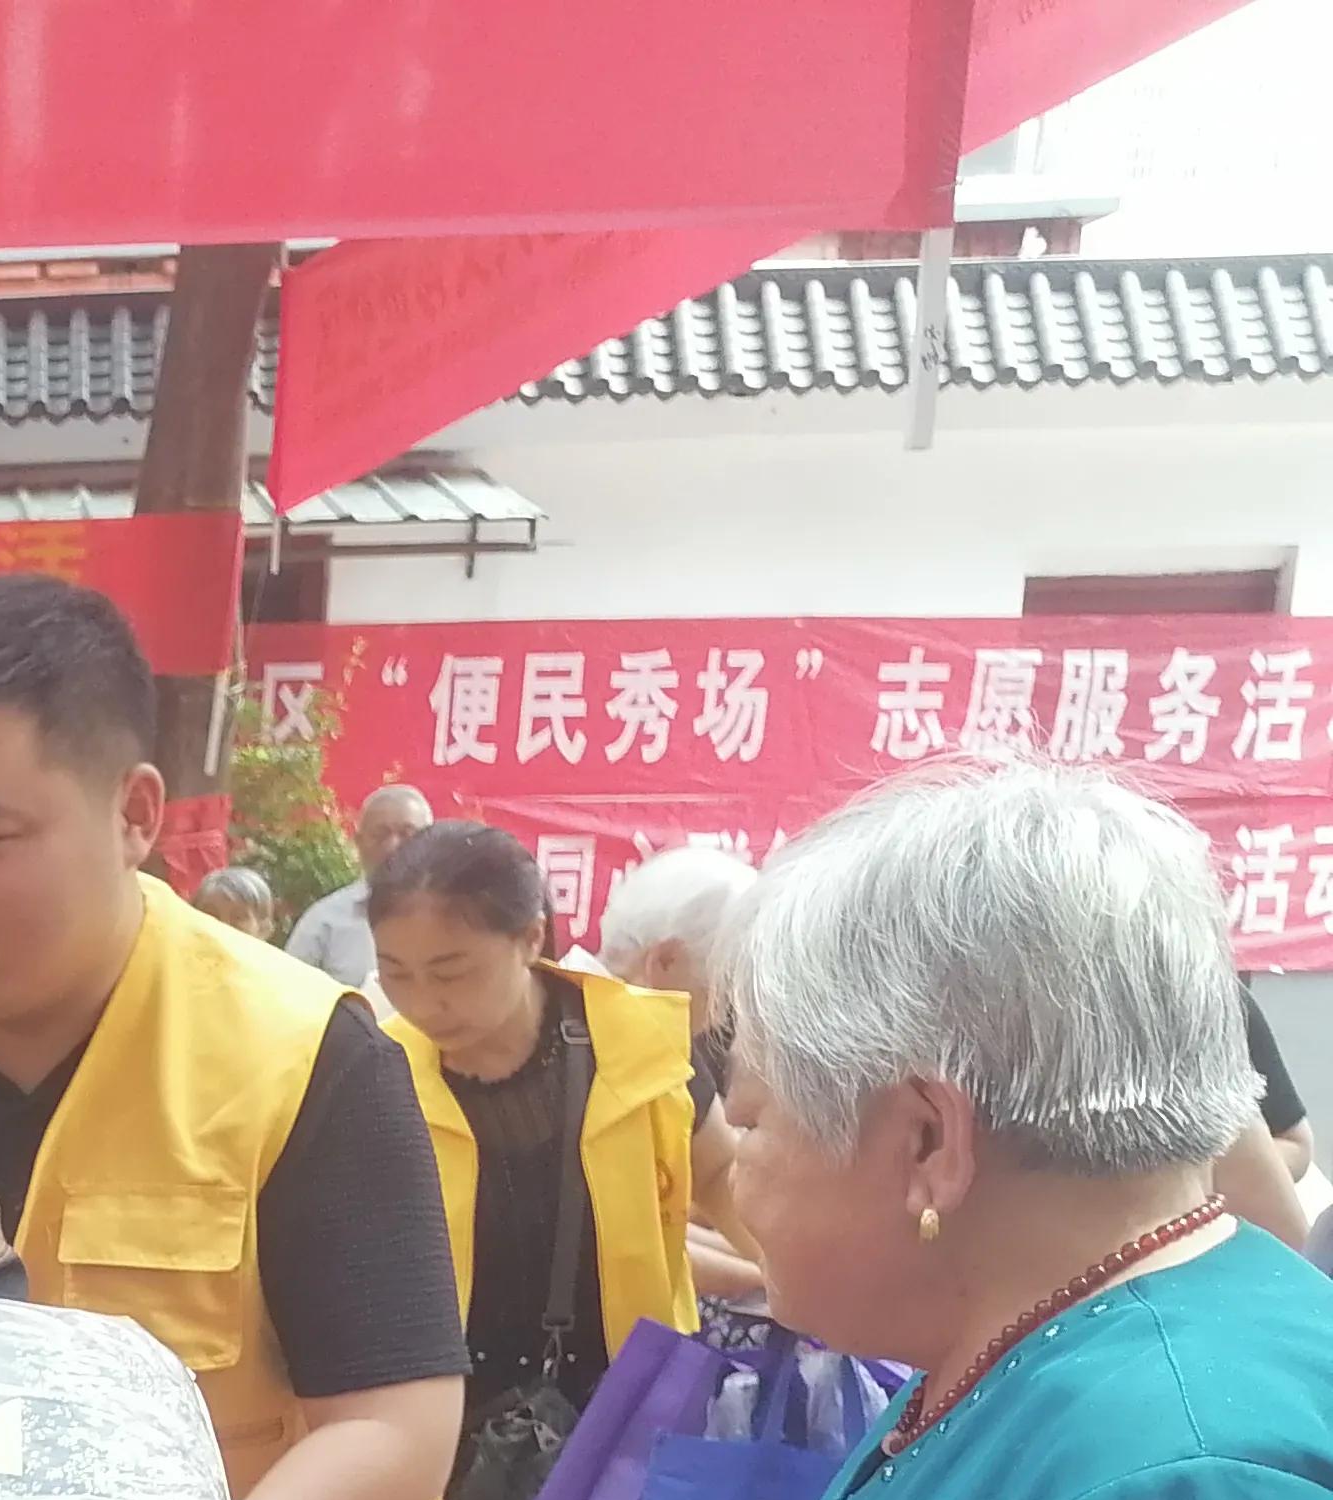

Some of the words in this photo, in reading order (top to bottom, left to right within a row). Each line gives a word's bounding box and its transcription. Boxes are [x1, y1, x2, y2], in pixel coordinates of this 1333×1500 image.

[261, 646, 1333, 766] 区“便民秀场”志愿服务活
